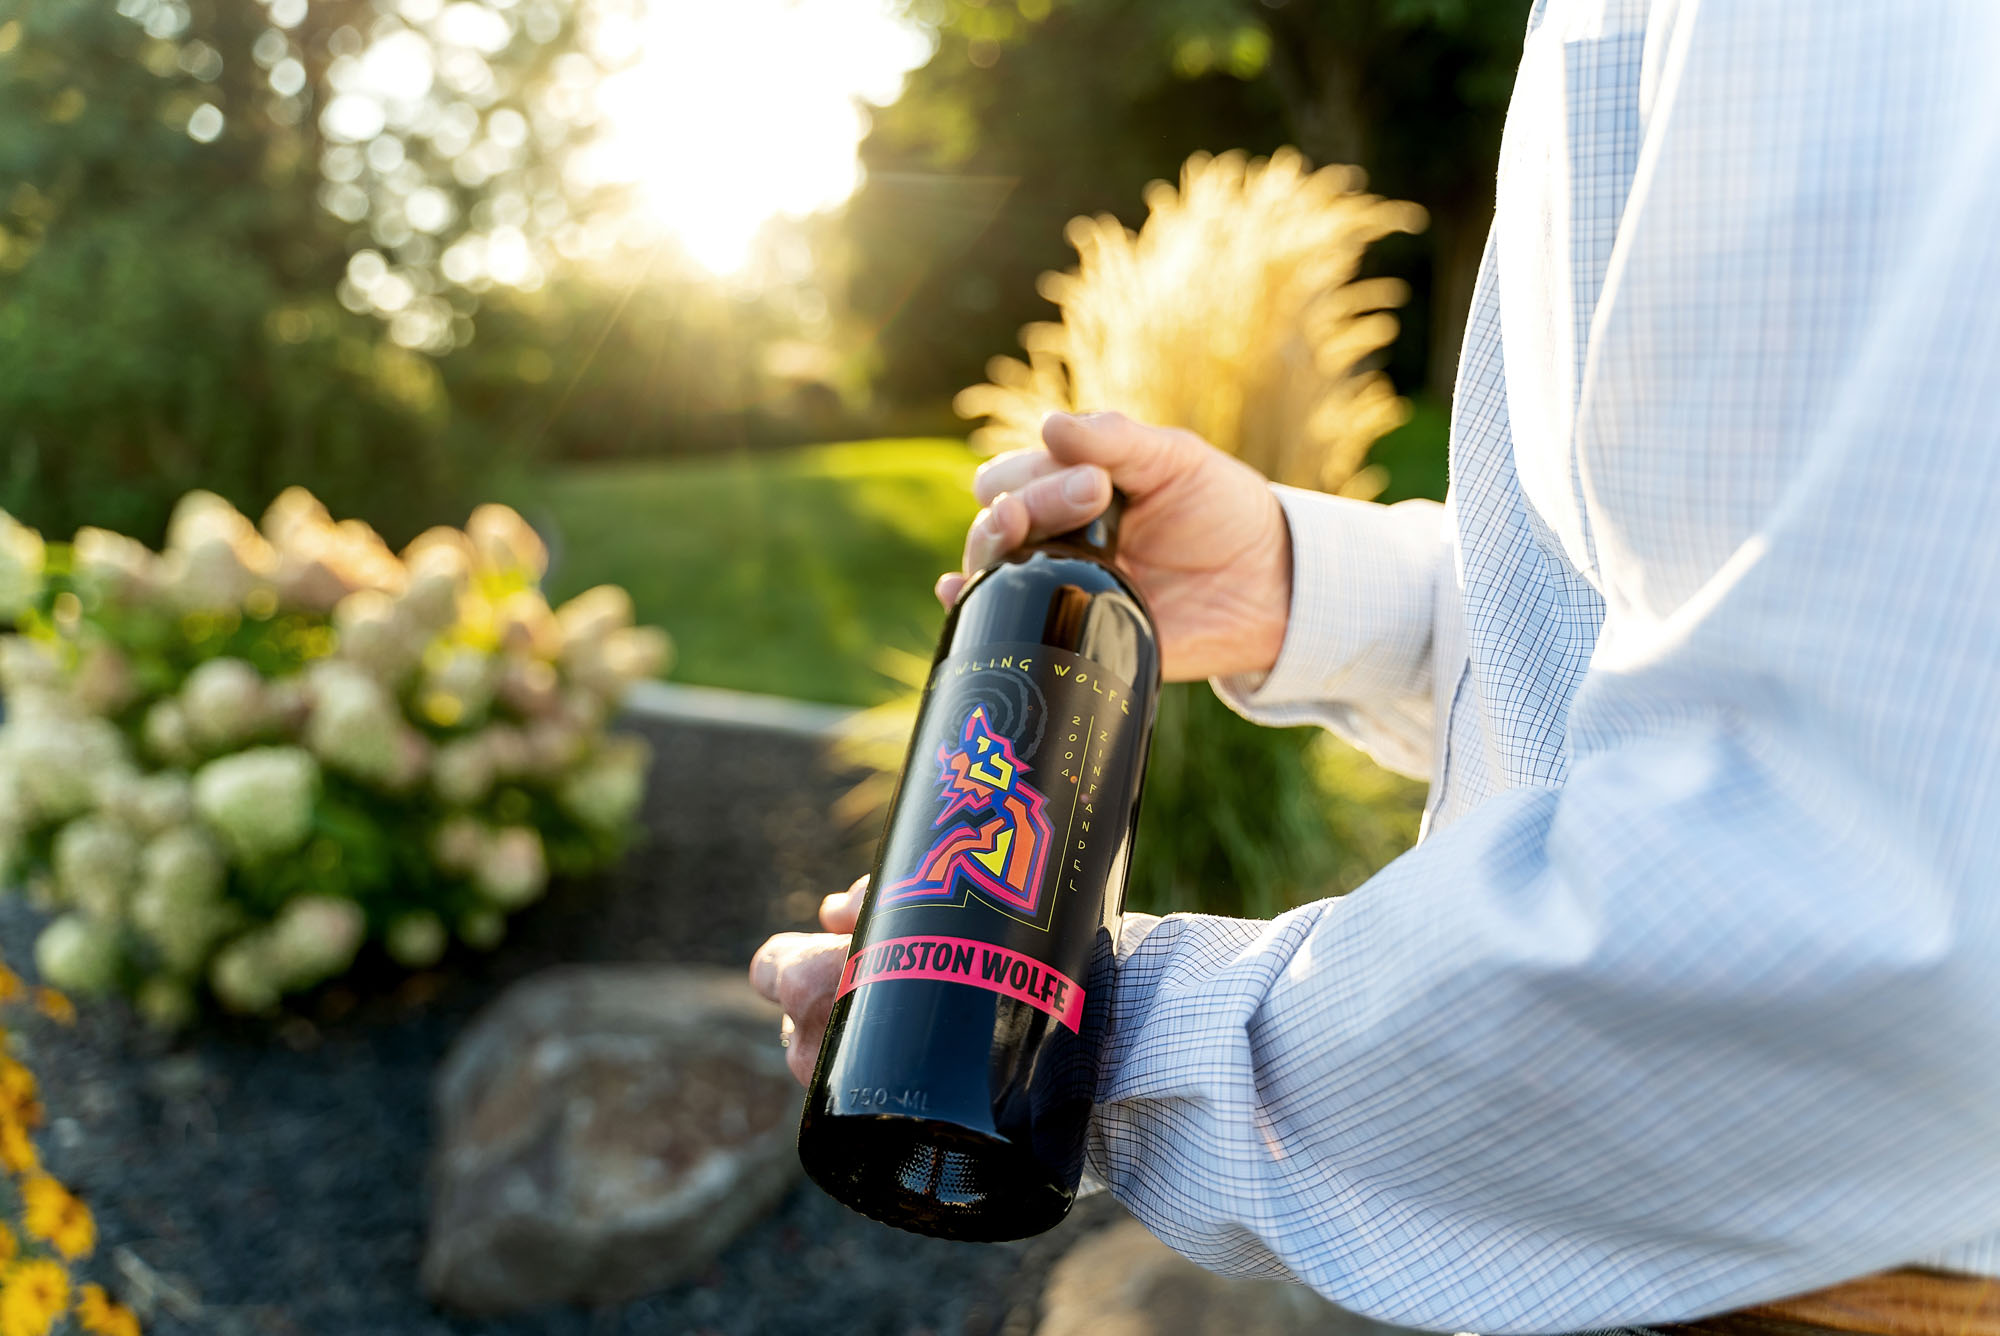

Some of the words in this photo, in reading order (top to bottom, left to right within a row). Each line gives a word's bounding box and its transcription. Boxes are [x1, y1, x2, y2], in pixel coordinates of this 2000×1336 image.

[930, 655, 1033, 690] WLING
[1053, 663, 1130, 716] WOLFE
[1061, 714, 1082, 778] 2004
[1069, 730, 1109, 892] ZINFANDEL
[850, 941, 976, 984] THURSTON
[981, 948, 1069, 1014] WOLFE
[850, 1086, 889, 1108] 750
